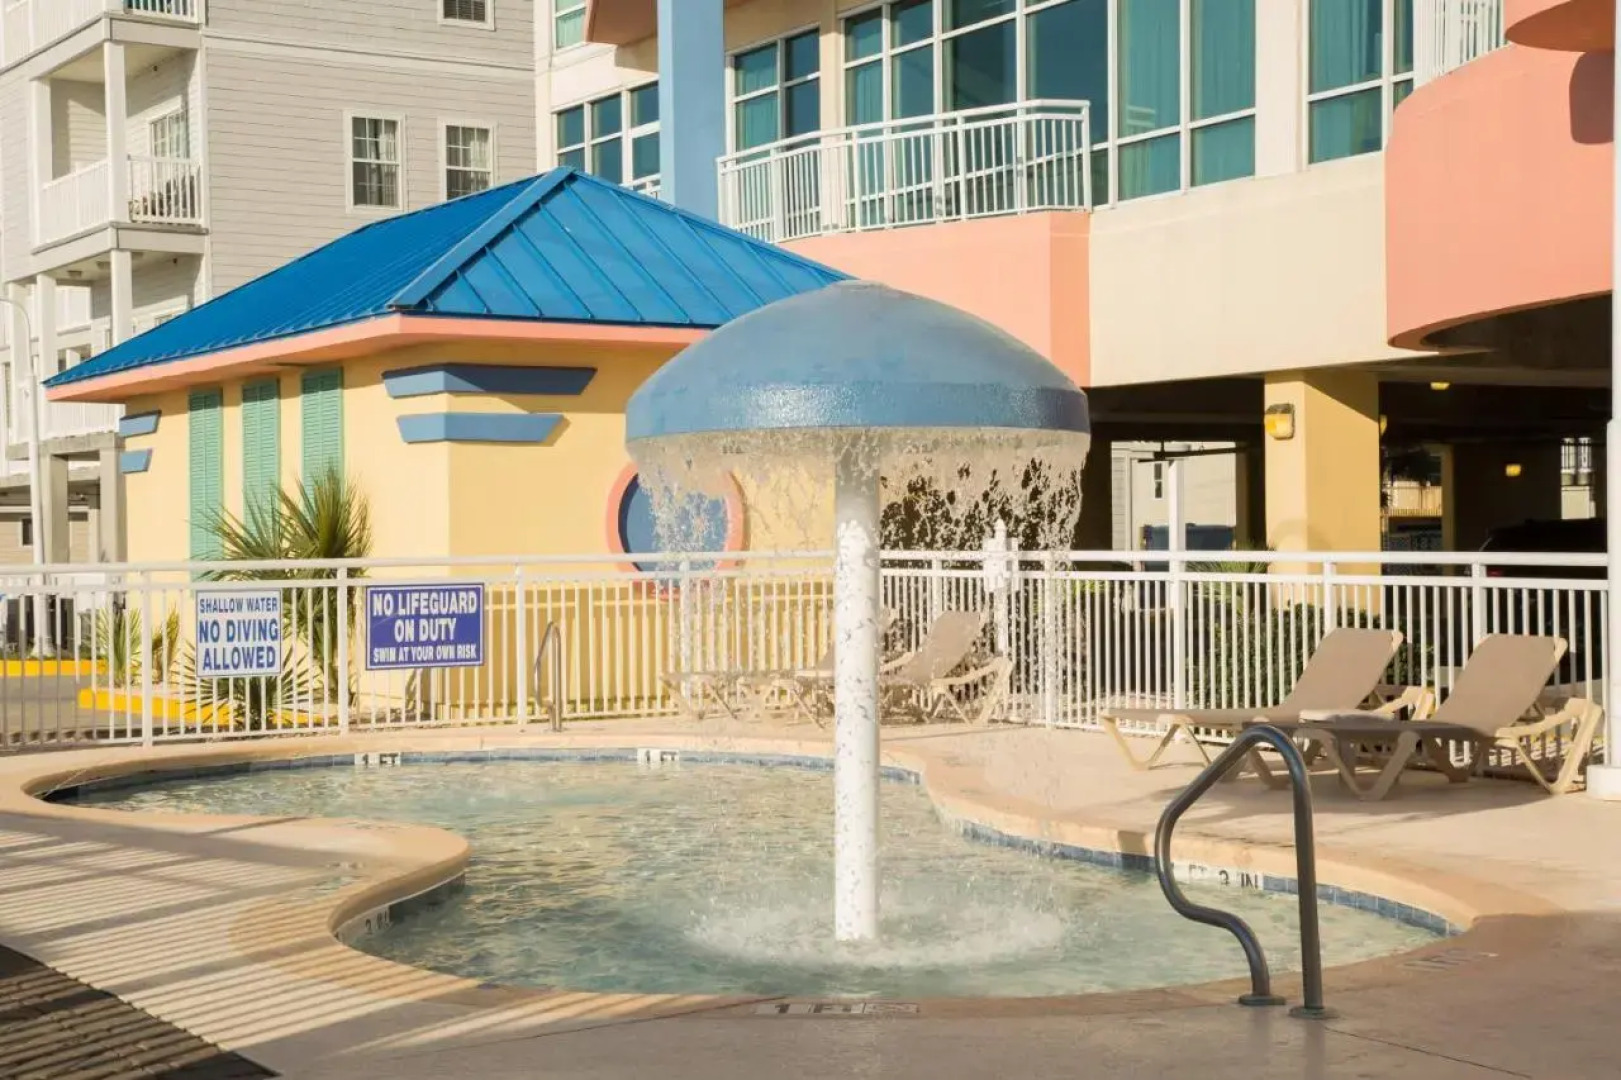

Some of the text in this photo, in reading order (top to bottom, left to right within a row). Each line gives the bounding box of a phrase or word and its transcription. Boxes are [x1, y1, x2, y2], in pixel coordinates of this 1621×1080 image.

[199, 597, 278, 614] SHALLOW WATER
[373, 590, 478, 617] NO LIFEGUARD
[199, 618, 279, 643] NO DIVING
[394, 617, 457, 643] ON DUTY
[202, 646, 276, 671] ALLOWED
[373, 643, 477, 663] SWIM AT YOUR OWN RISK
